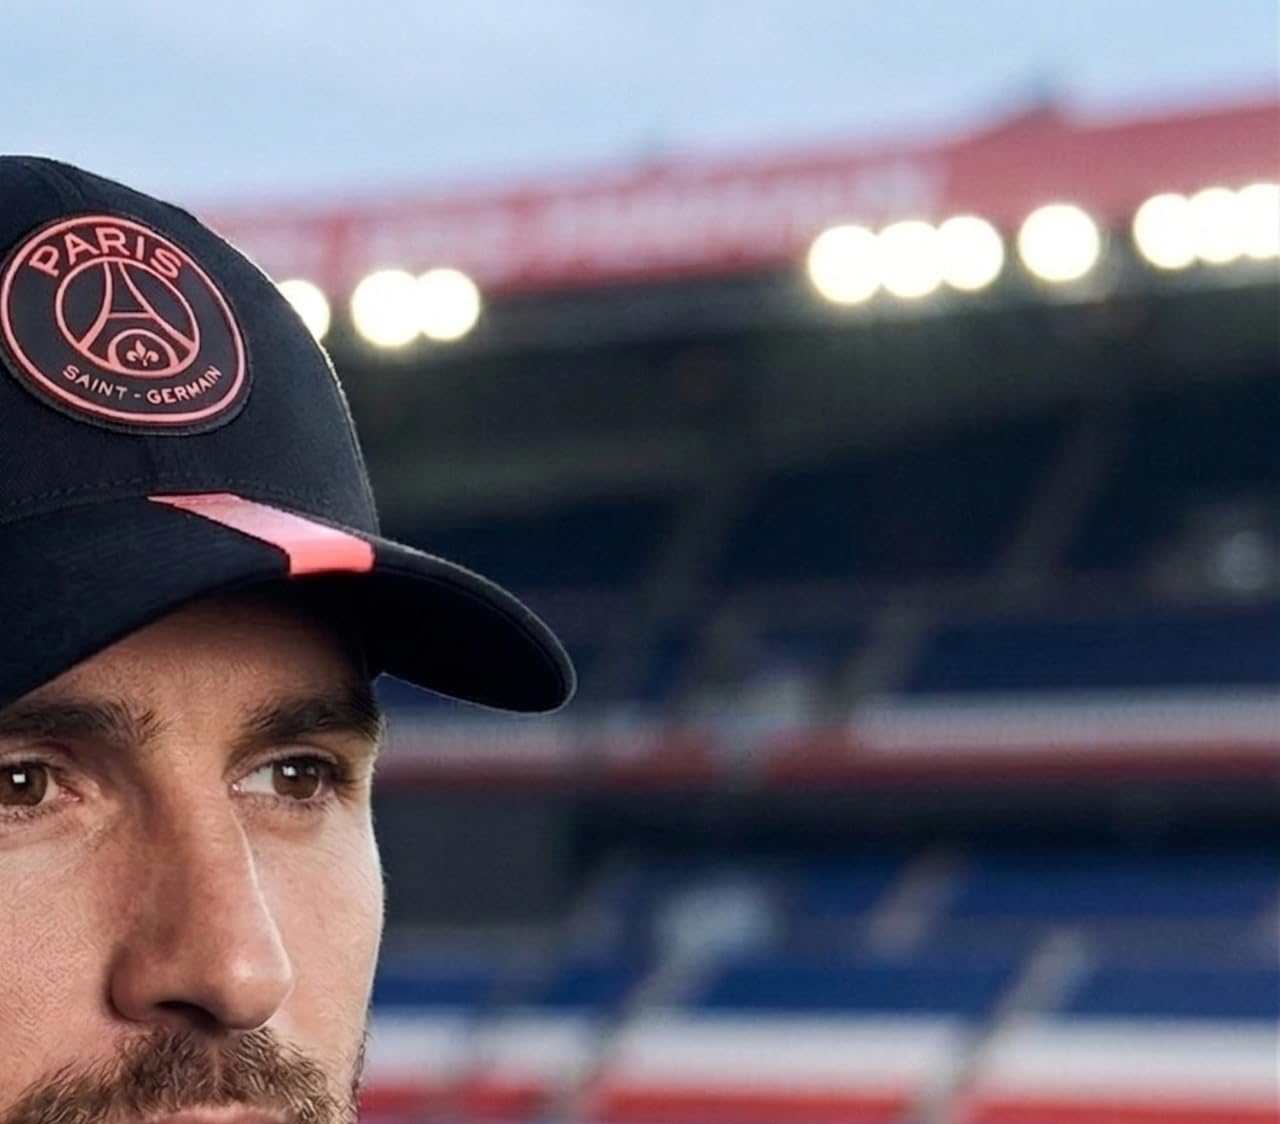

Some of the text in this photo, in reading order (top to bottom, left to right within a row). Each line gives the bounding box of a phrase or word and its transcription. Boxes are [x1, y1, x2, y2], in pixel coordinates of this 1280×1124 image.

[28, 227, 183, 279] PARIS
[62, 364, 128, 400] SAINT
[146, 365, 223, 405] GERMAIN
